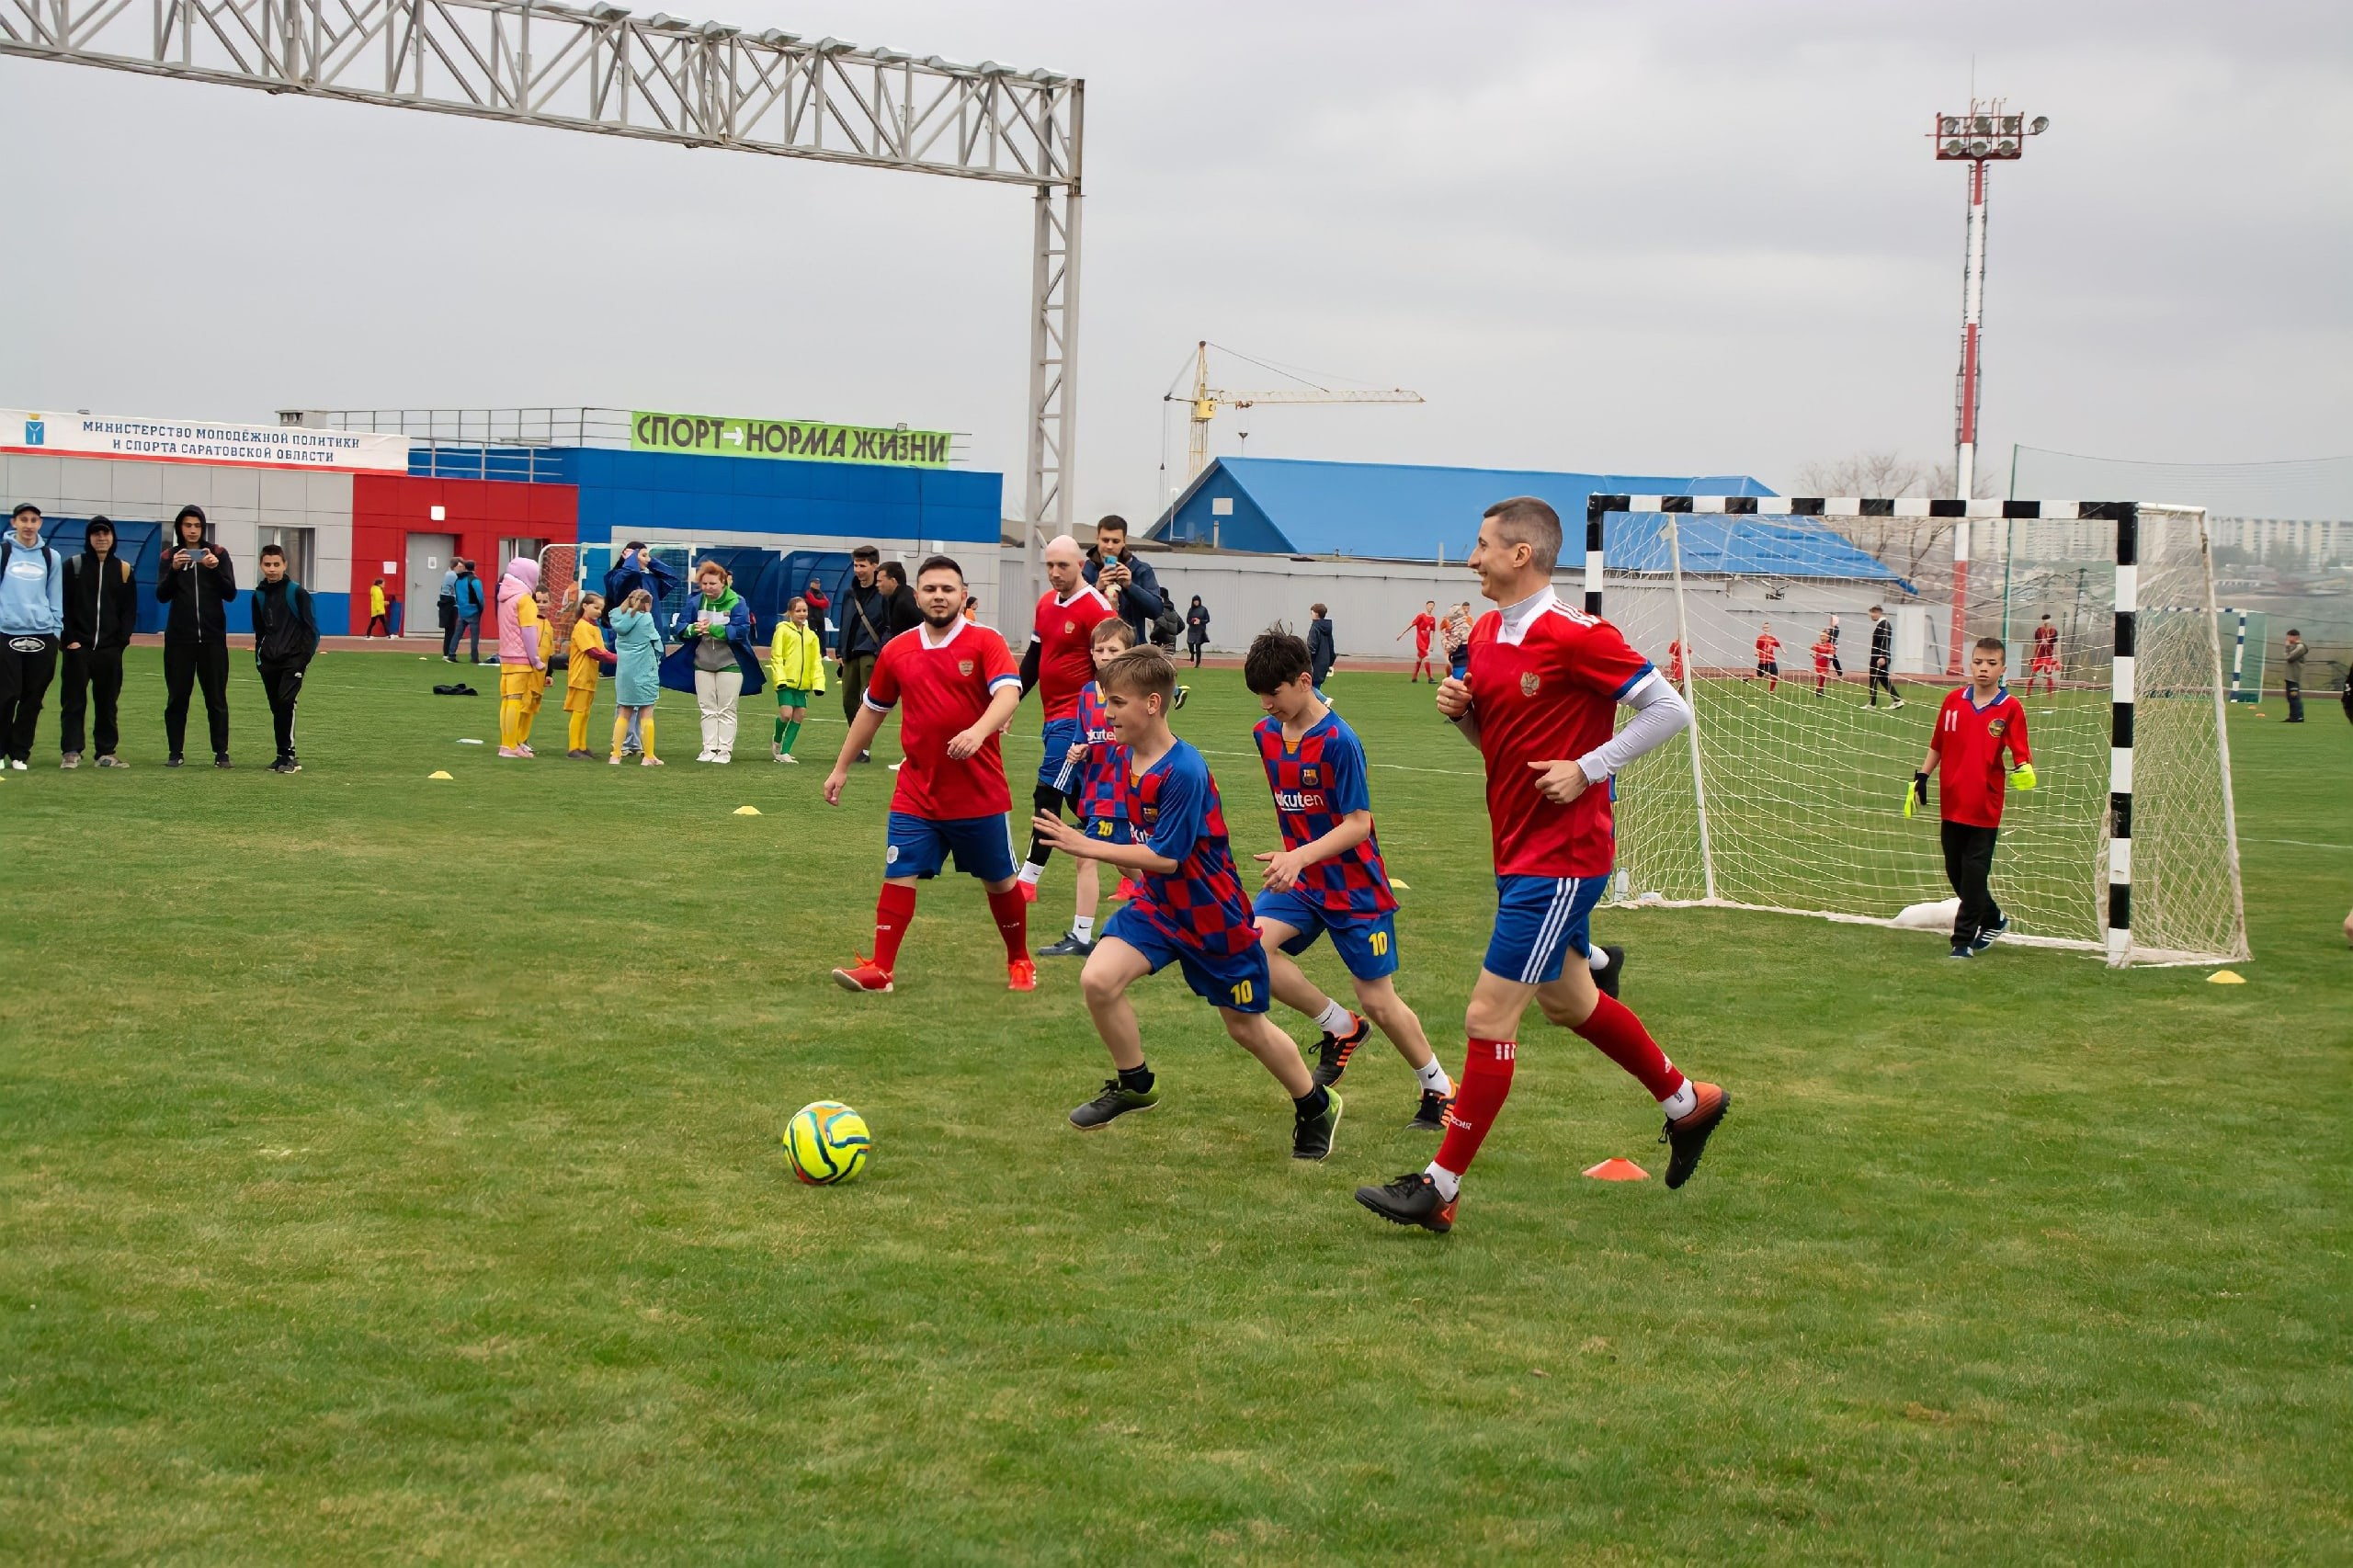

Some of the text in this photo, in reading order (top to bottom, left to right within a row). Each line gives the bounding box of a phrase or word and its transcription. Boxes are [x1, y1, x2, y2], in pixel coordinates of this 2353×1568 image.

[83, 421, 359, 448] МИНИСТЕРСТВО МОЛОДЁЖНОЙ ПОЛИТИКИ
[637, 415, 947, 462] СПОРТ НОРМА ЖИЗНИ
[113, 439, 334, 462] И СПОРТА САРАТОВСКОЙ ОБЛАСТИ
[1944, 710, 1958, 732] 11
[1097, 820, 1113, 836] 10
[1368, 931, 1388, 957] 10
[1230, 980, 1253, 1005] 10
